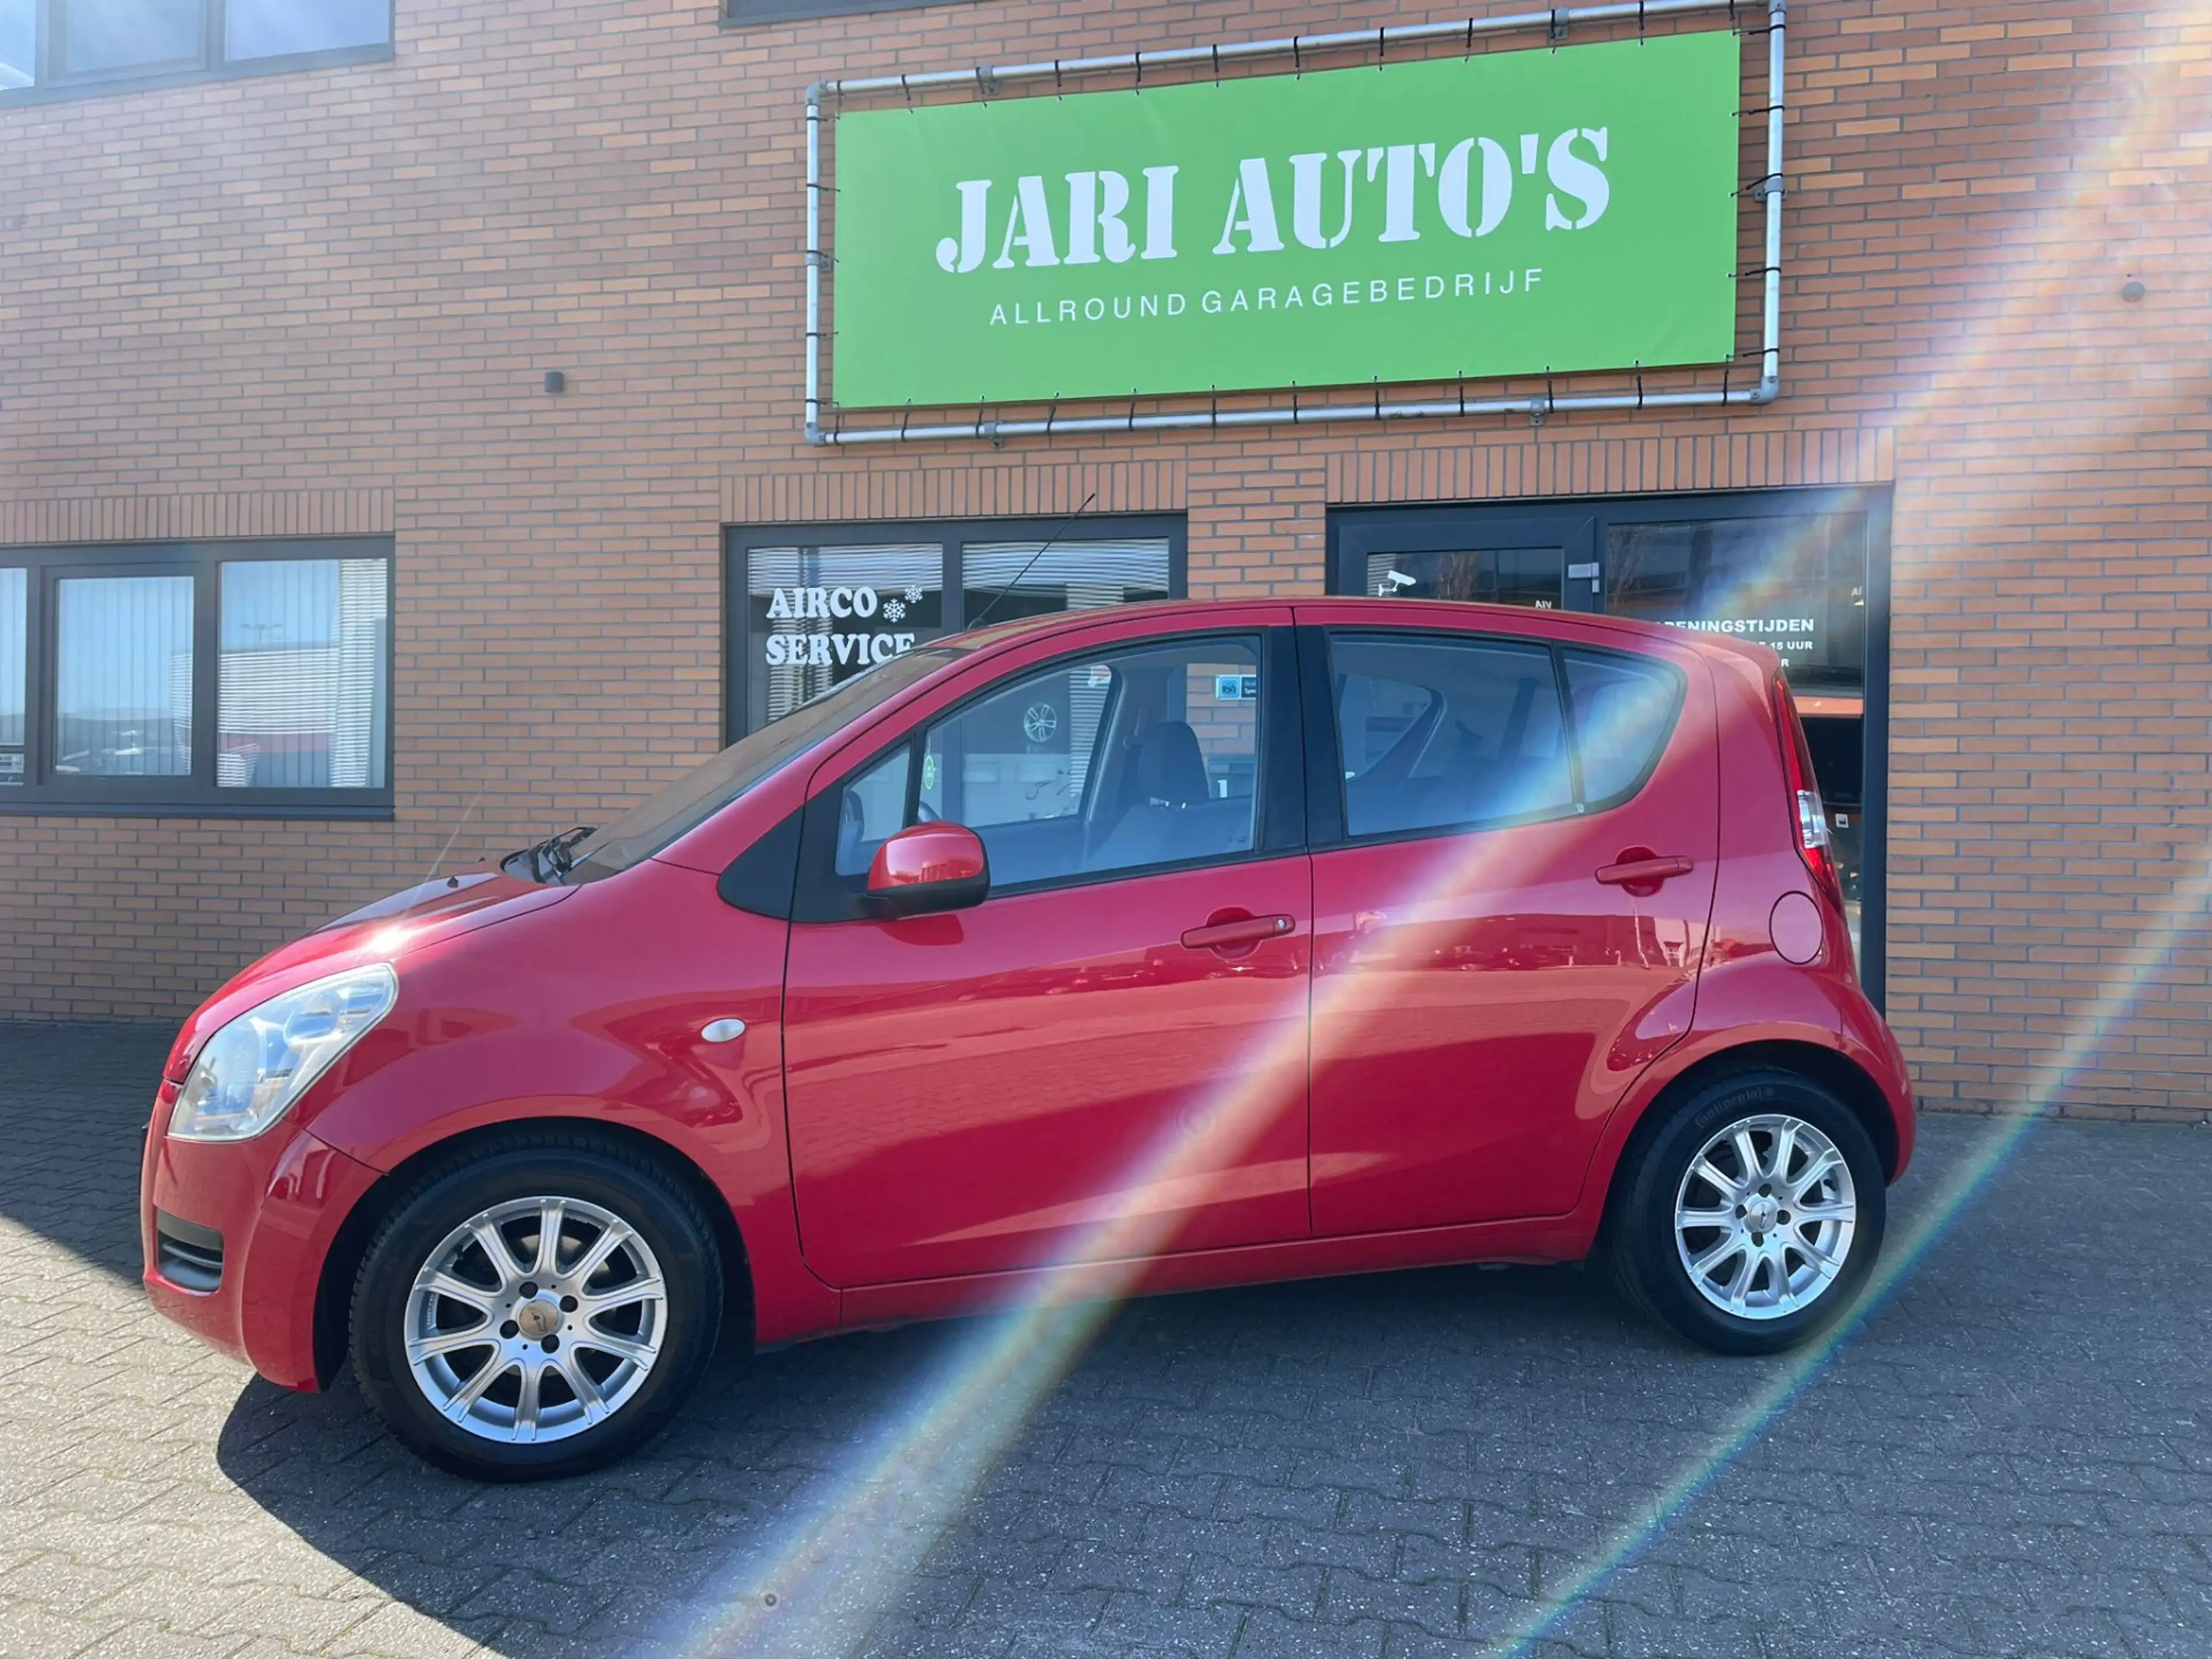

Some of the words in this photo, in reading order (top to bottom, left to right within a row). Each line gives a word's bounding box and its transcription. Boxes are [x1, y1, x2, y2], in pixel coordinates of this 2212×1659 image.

[935, 165, 1179, 273] JARI
[1213, 127, 1610, 255] AUTO'S
[990, 293, 1186, 325] ALLROUND
[1202, 268, 1543, 312] GARAGEBEDRIJF
[766, 586, 878, 619] AIRCO
[1657, 619, 1815, 632] ENINGSTIJDEN
[1787, 641, 1813, 650] UUR
